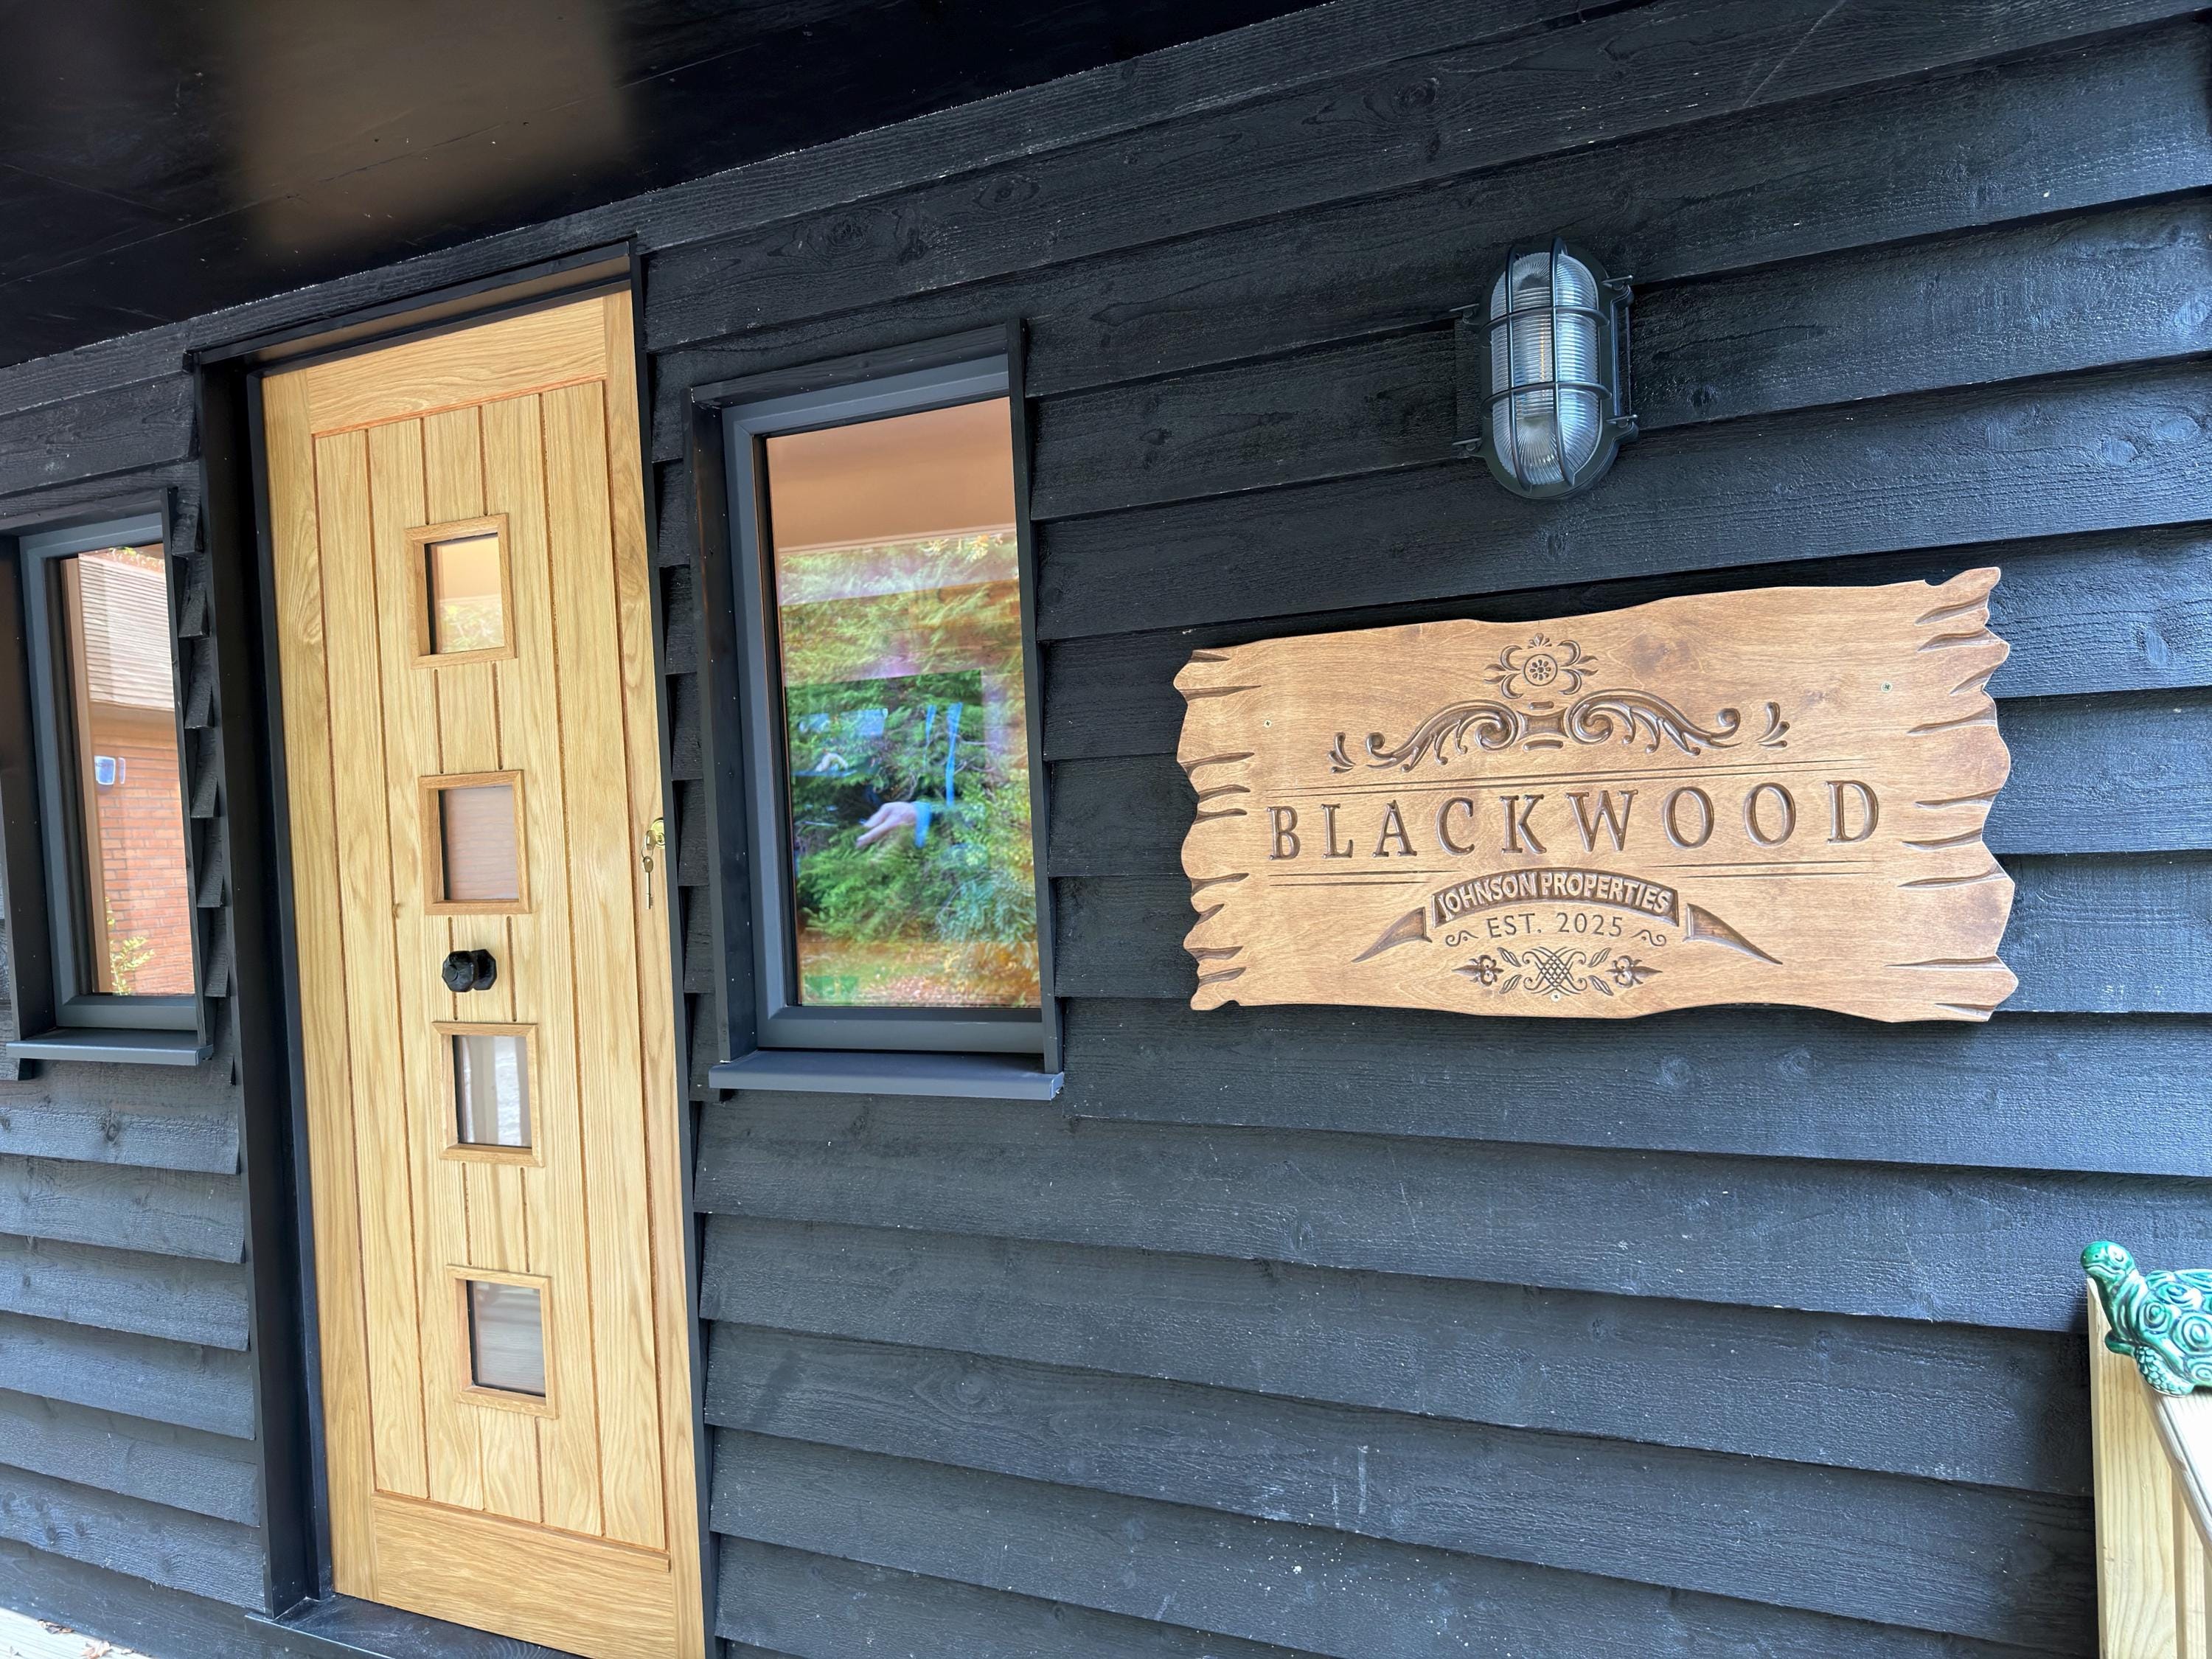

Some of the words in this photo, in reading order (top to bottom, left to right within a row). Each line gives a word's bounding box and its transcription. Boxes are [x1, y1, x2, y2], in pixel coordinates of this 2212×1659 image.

[1267, 779, 1880, 860] BLACKWOOD
[1438, 872, 1537, 922] JOHNSON
[1540, 872, 1673, 914] PROPERTIES
[1486, 912, 1543, 939] EST.
[1556, 911, 1623, 937] 2025
